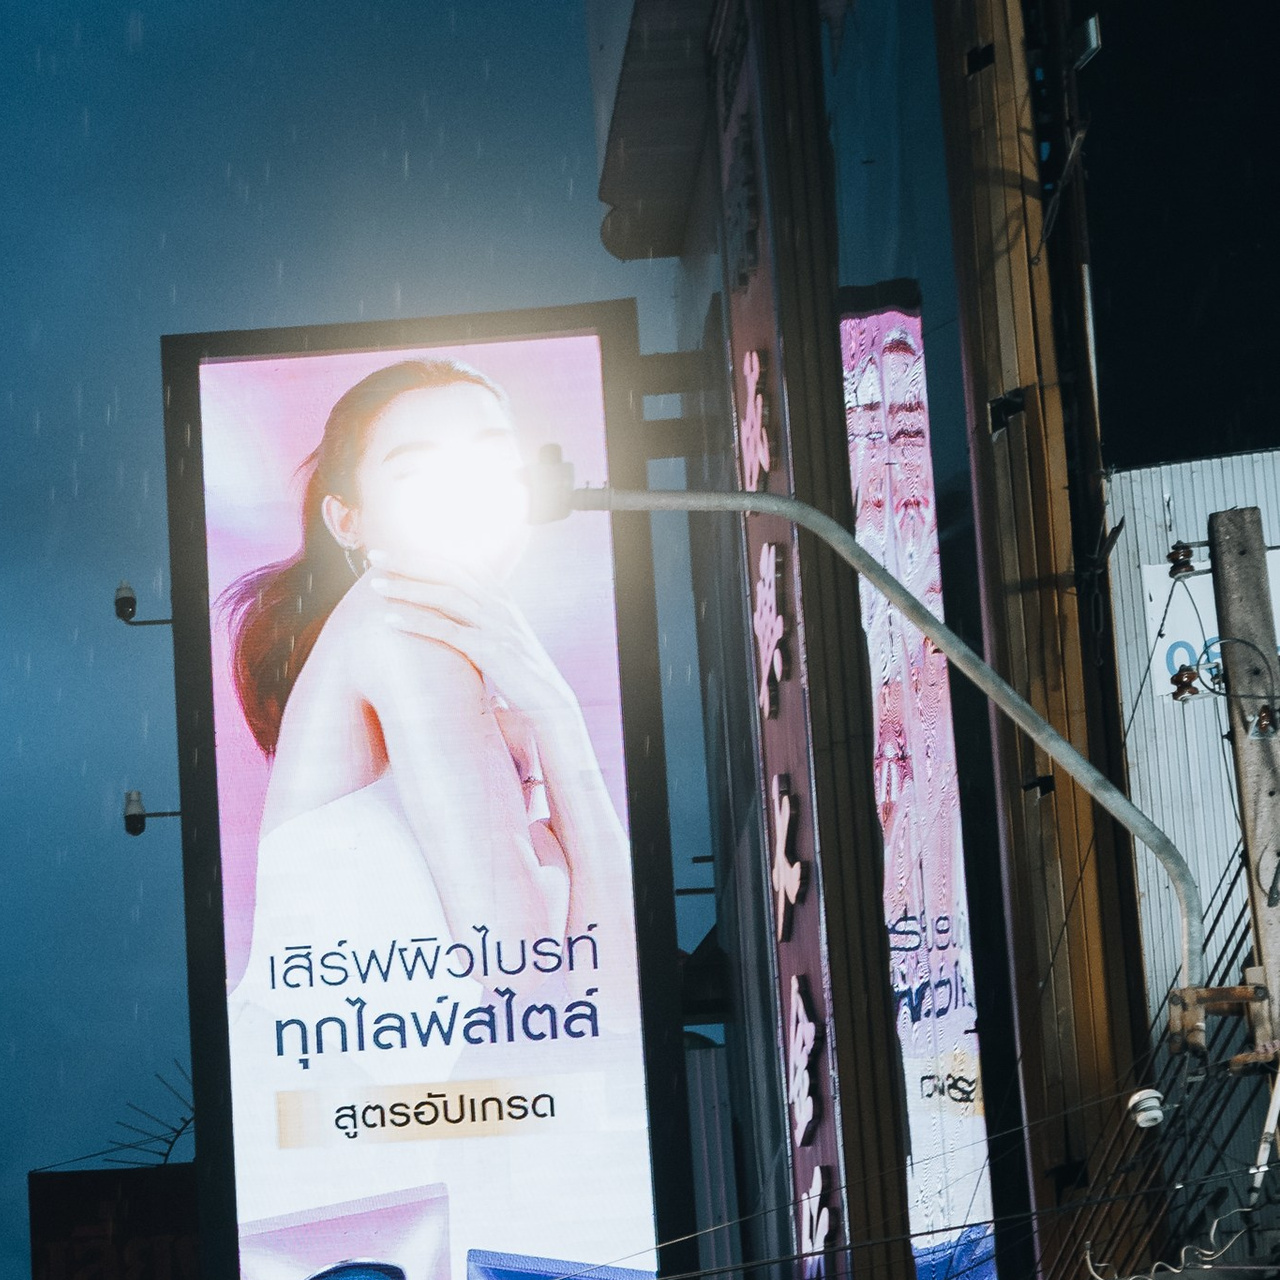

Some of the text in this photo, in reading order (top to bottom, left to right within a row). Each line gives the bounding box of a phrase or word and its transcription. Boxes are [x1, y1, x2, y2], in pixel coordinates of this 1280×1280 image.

[268, 923, 601, 992] เสิร์ฟผิวไบรท์
[274, 988, 601, 1070] ทุกไลฟ์สไตล์
[334, 1088, 557, 1139] สูตรอัปเกรด
